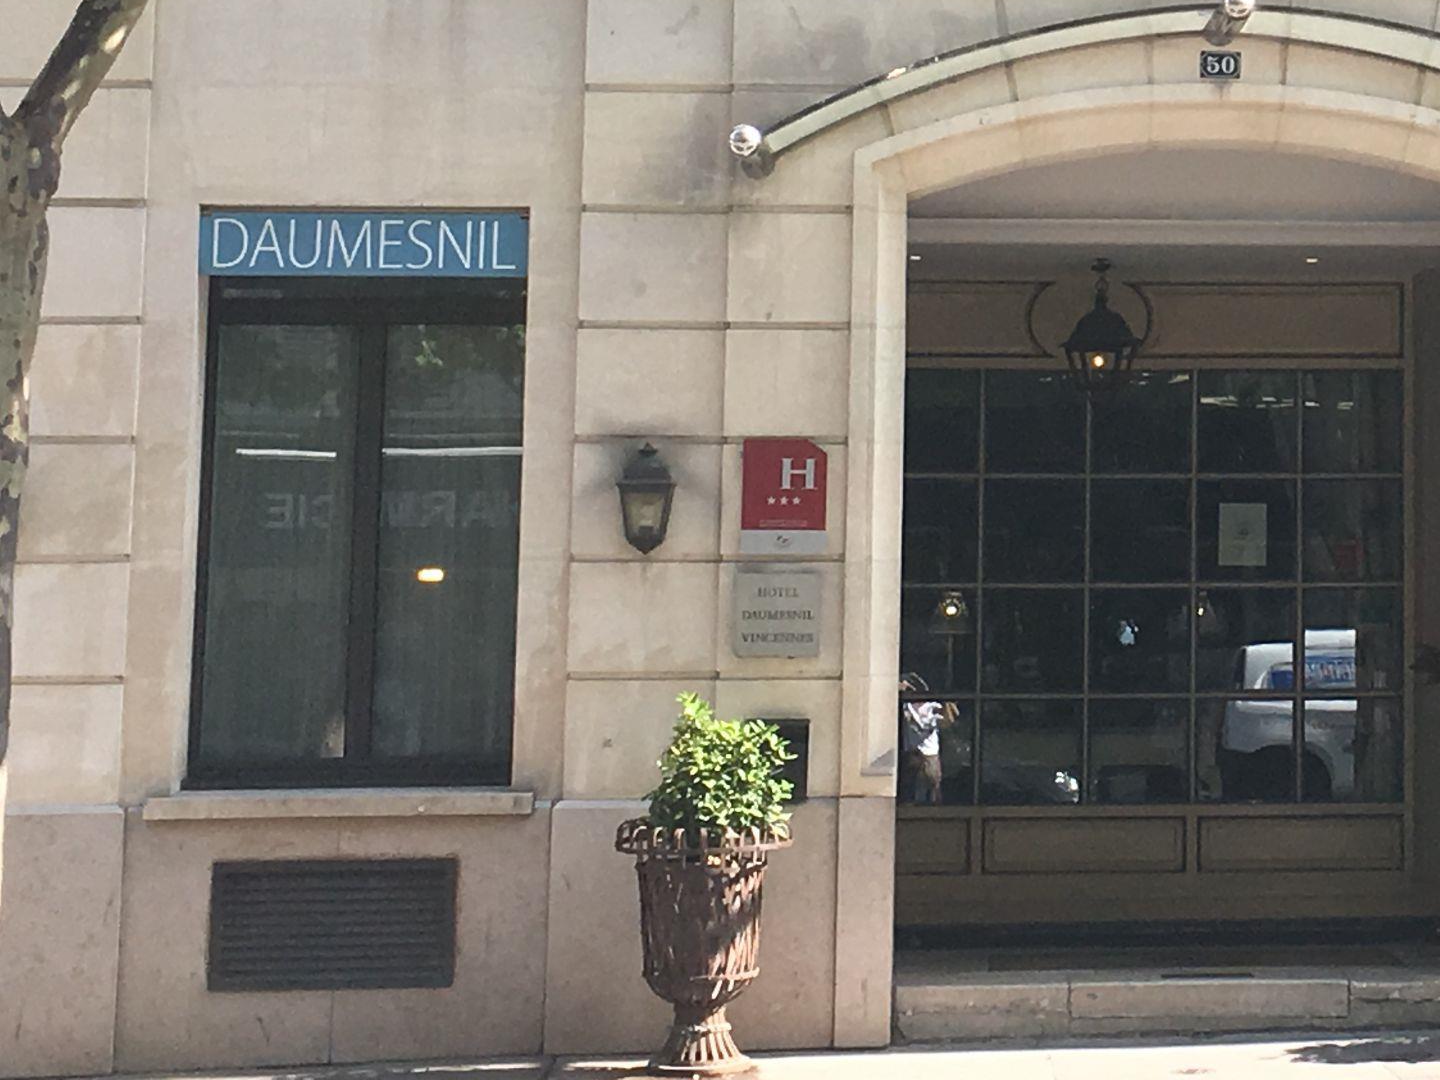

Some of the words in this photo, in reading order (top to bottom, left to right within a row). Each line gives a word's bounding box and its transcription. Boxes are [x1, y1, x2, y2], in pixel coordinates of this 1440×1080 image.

[1206, 55, 1235, 74] 50
[211, 217, 516, 270] DAUMESNIL
[780, 457, 817, 490] H
[757, 586, 799, 599] HOTEL
[741, 609, 815, 621] DAUMESNIL
[741, 631, 815, 644] VINCENNES
